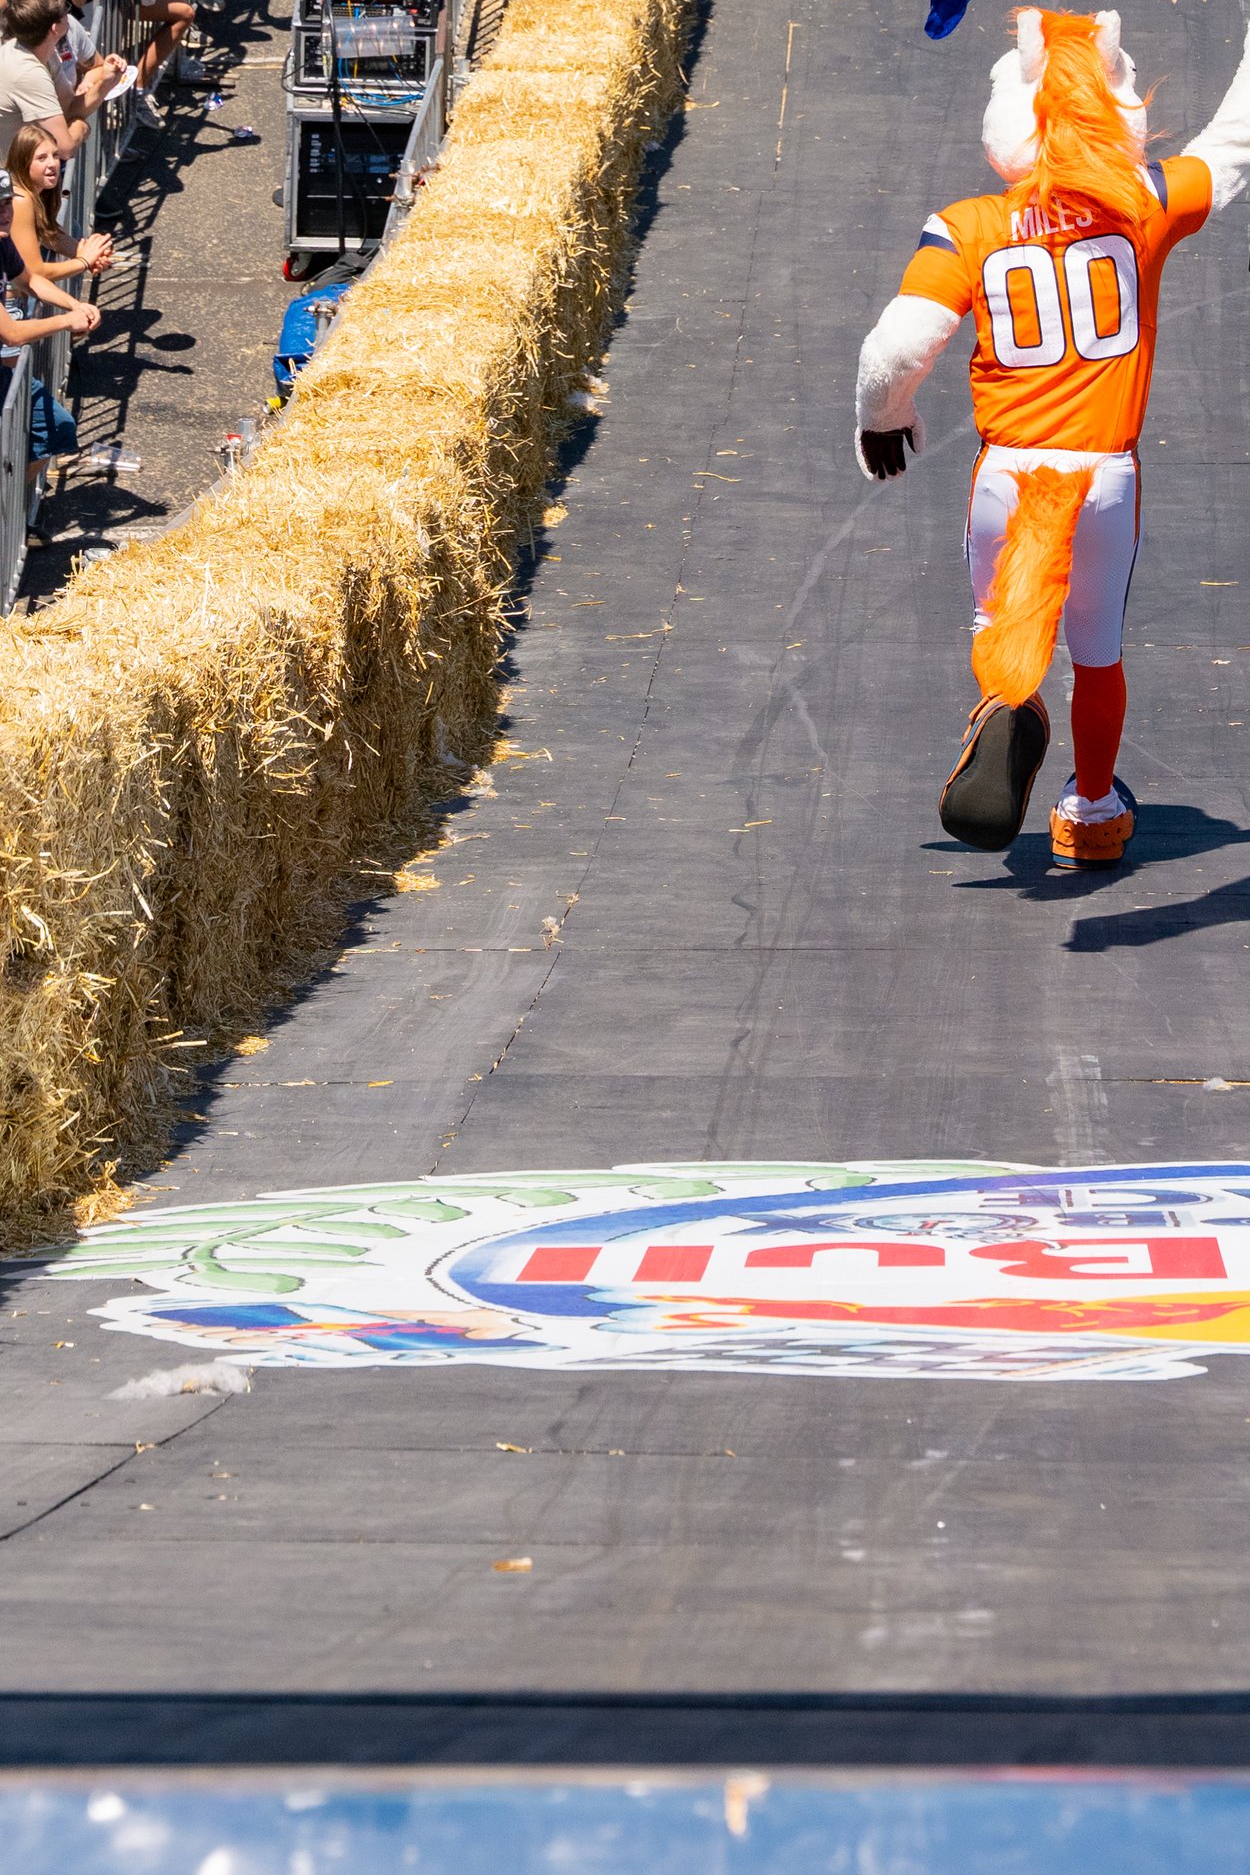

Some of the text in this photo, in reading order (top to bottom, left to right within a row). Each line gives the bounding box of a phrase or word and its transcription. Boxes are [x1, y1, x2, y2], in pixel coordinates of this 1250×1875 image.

[1010, 198, 1093, 242] MILES
[982, 233, 1140, 368] 00
[515, 1236, 1229, 1283] Bull
